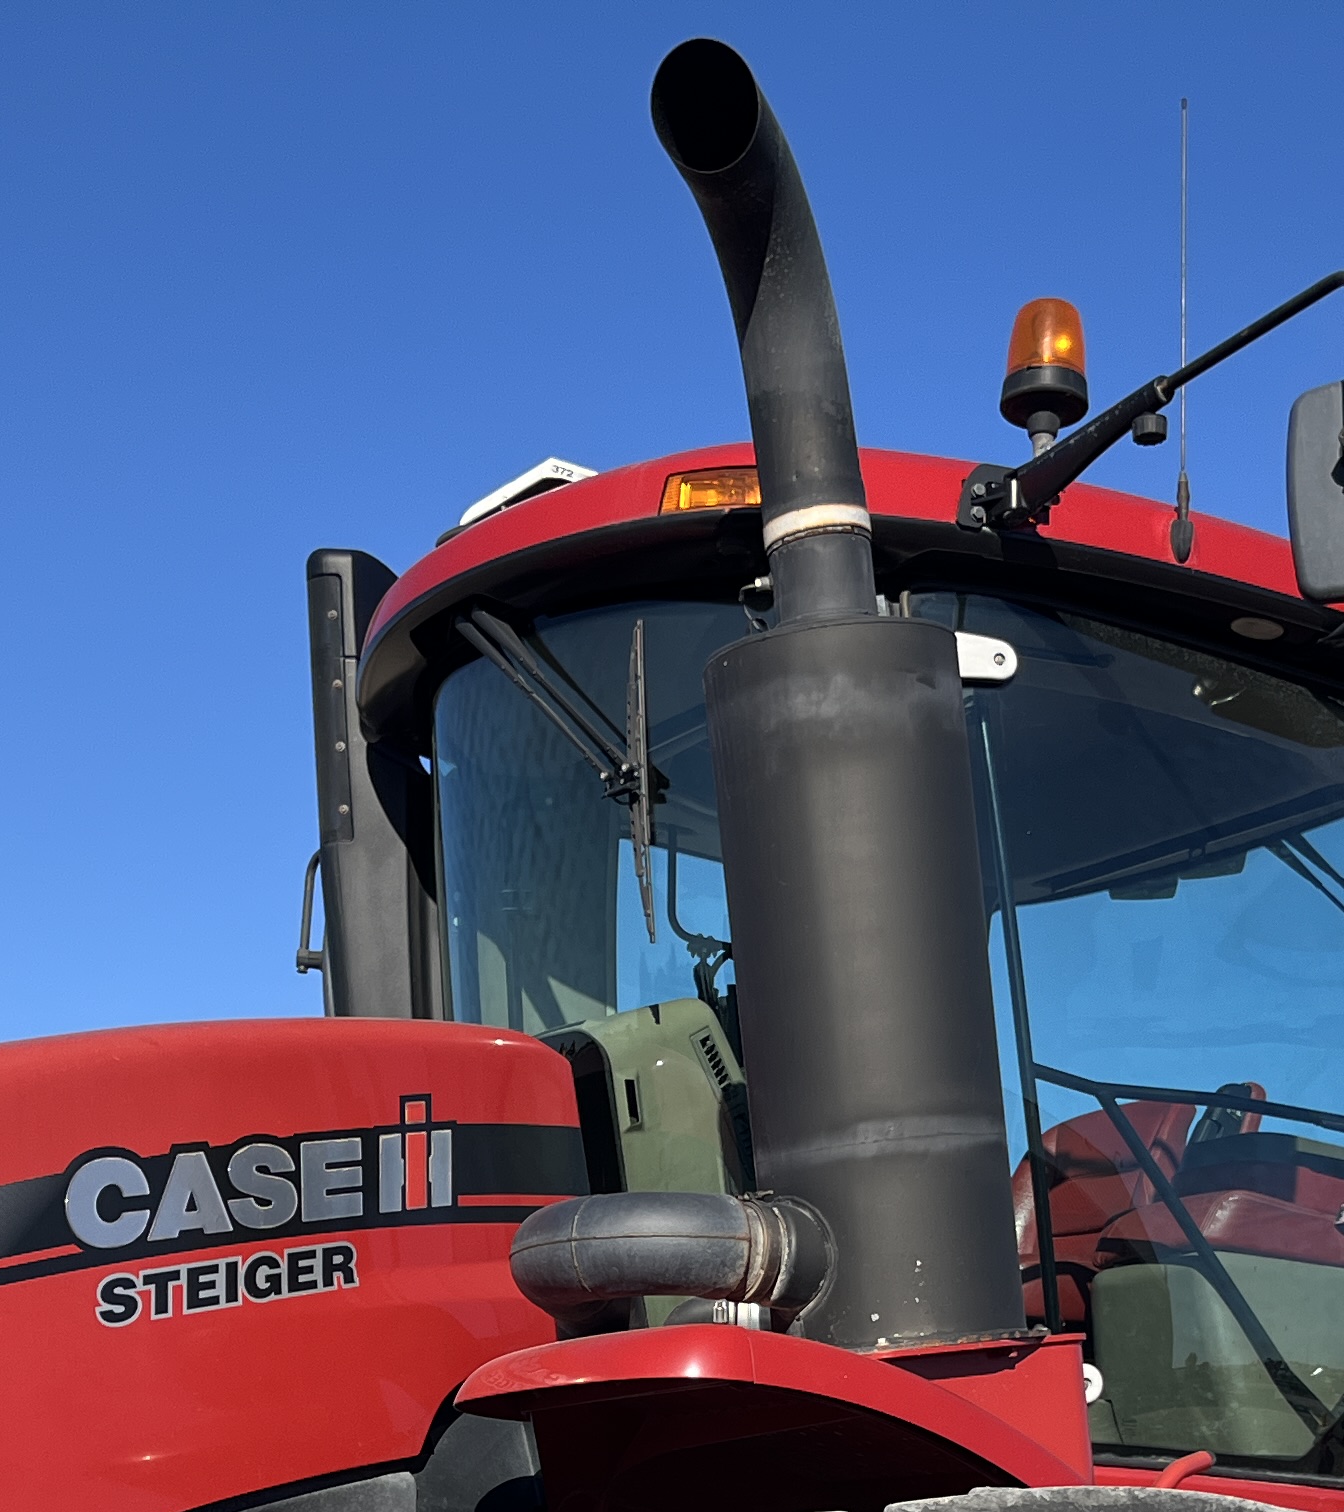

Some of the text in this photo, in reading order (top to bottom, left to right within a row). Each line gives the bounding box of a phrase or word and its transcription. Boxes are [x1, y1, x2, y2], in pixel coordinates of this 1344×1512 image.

[551, 464, 574, 479] 372
[65, 1137, 364, 1249] CASE
[94, 1240, 360, 1328] STEIGER
